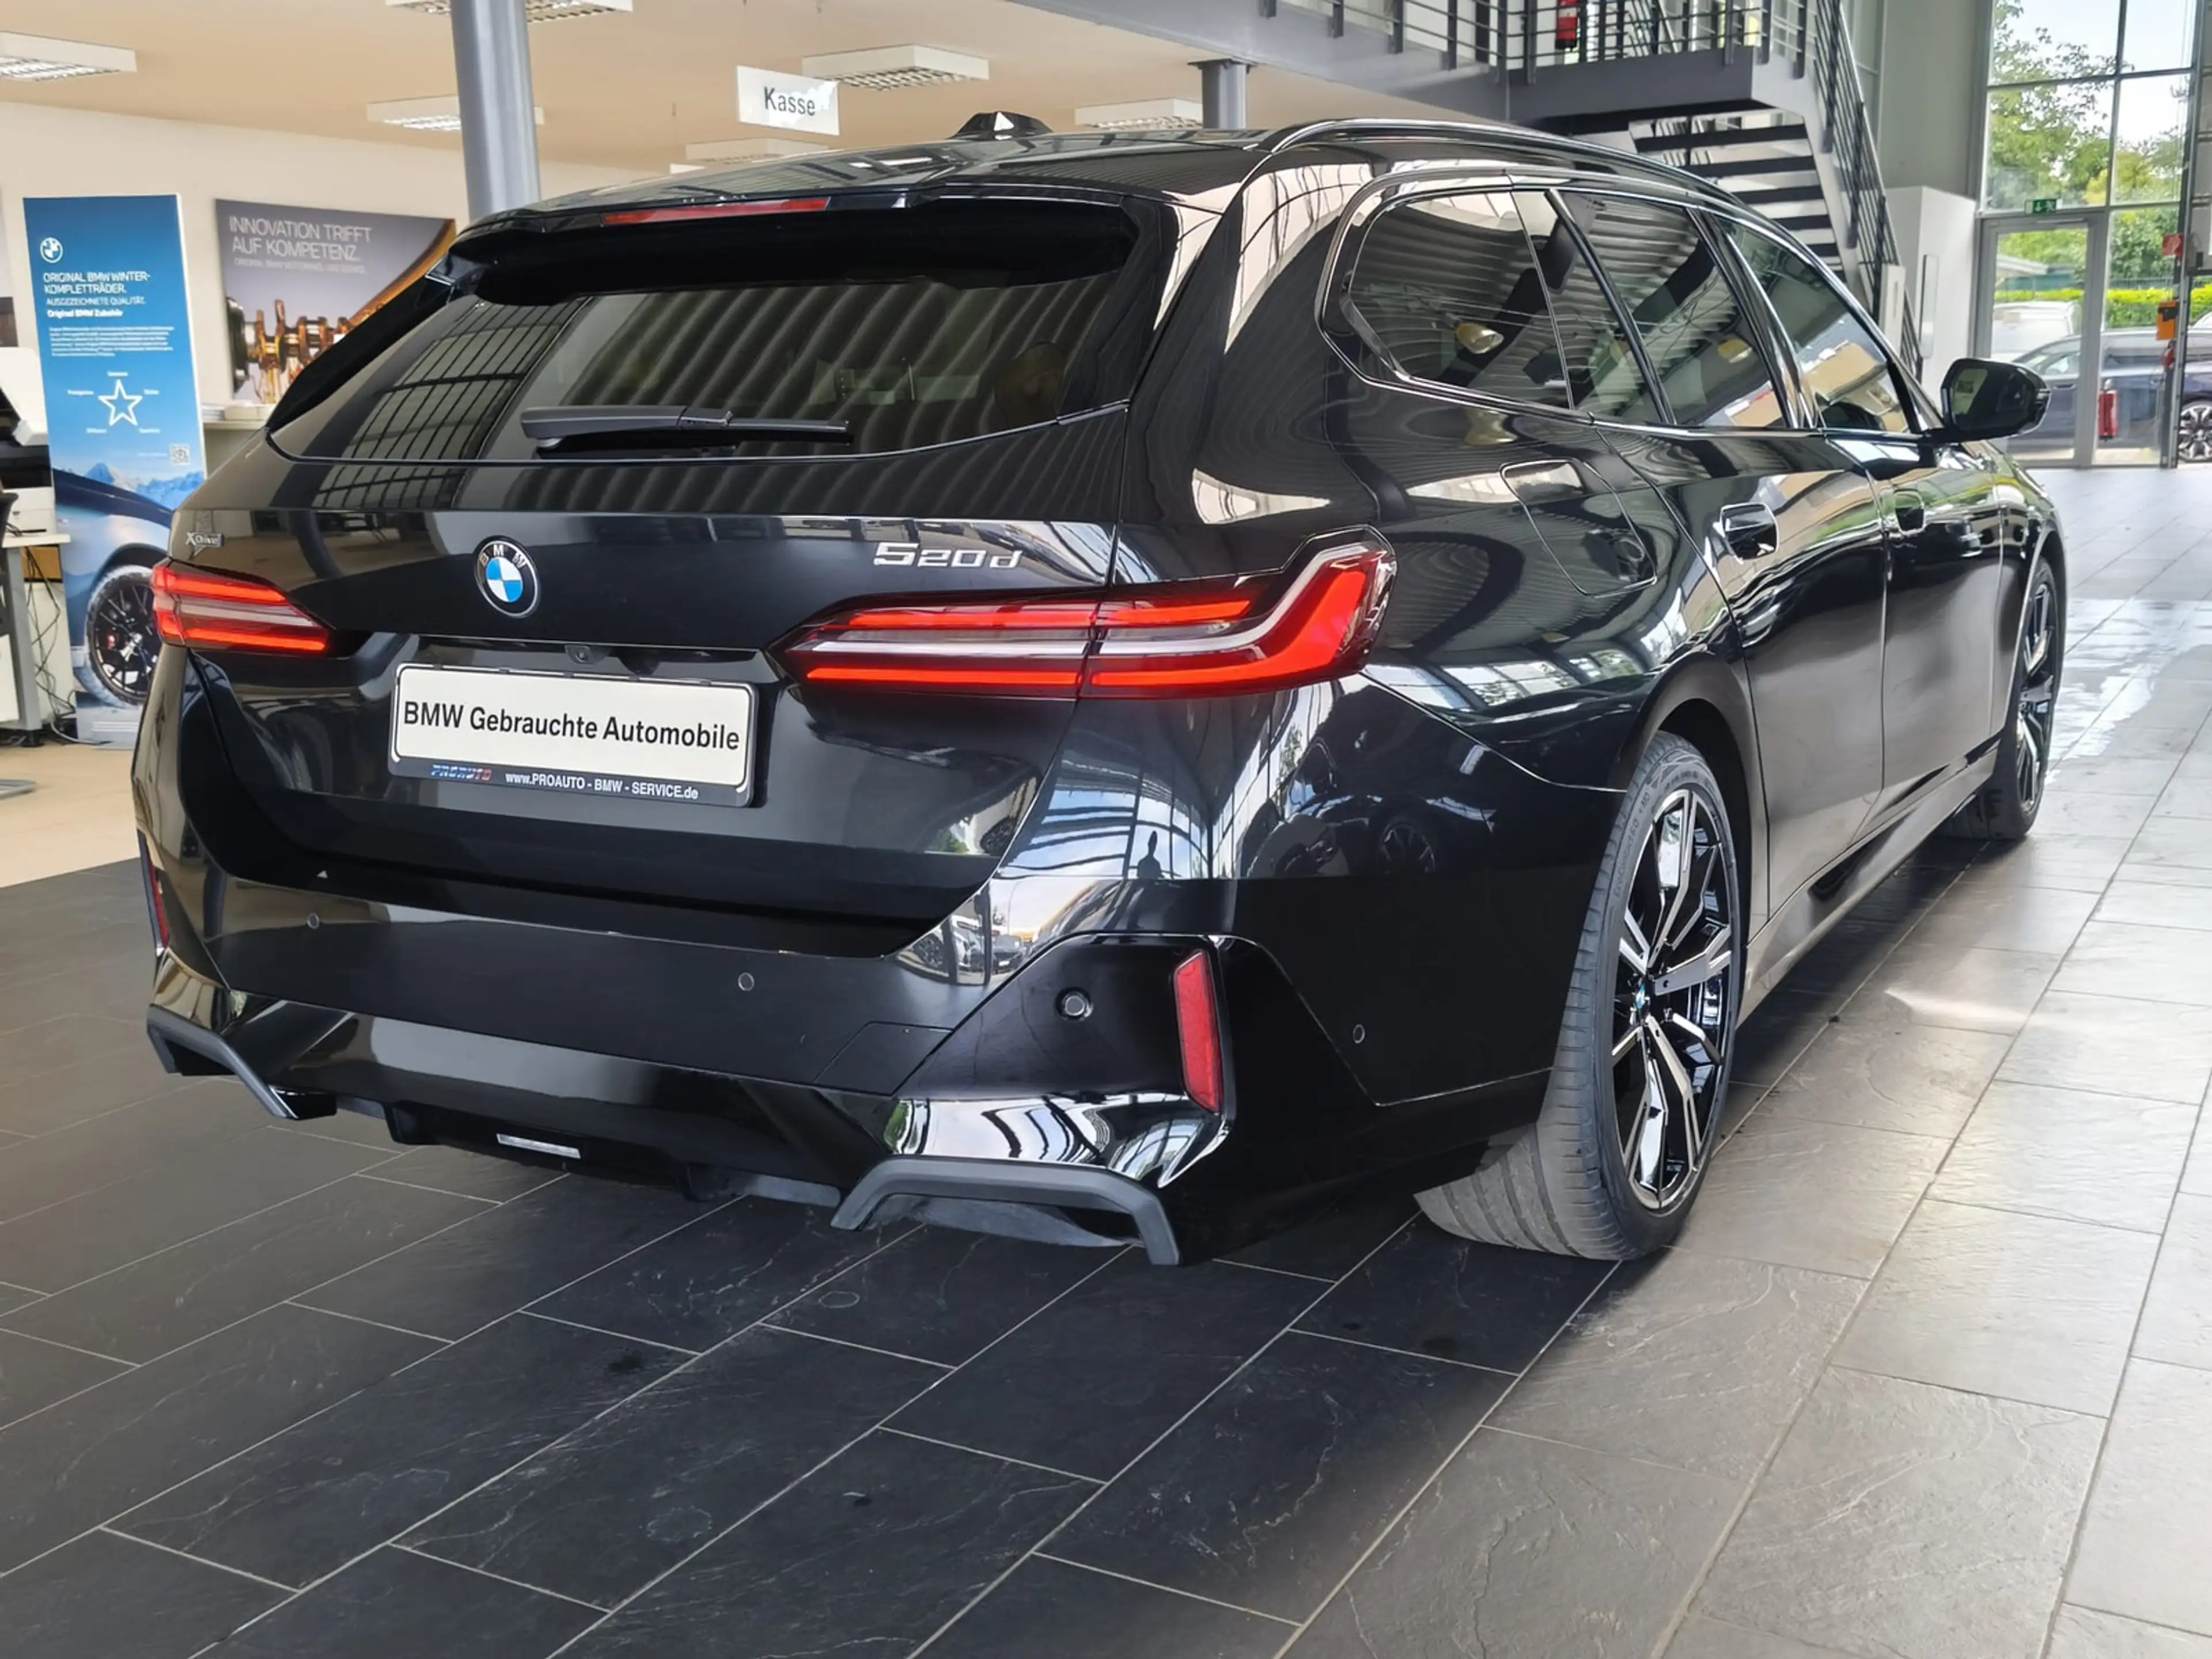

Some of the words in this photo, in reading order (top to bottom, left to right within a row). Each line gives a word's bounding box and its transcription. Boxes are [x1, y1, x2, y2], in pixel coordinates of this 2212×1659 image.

[764, 86, 815, 116] Kasse
[229, 215, 320, 239] INNOVATION
[323, 224, 372, 242] TRIFFT
[232, 236, 262, 254] AUF
[43, 272, 86, 283] ORIGINAL
[87, 272, 111, 282] BMW
[112, 271, 150, 281] WINTER-
[479, 544, 527, 569] BMW
[404, 700, 464, 728] BMW
[470, 706, 597, 739] Gebrauchte
[602, 716, 740, 749] Automobile
[594, 779, 623, 793] BMW
